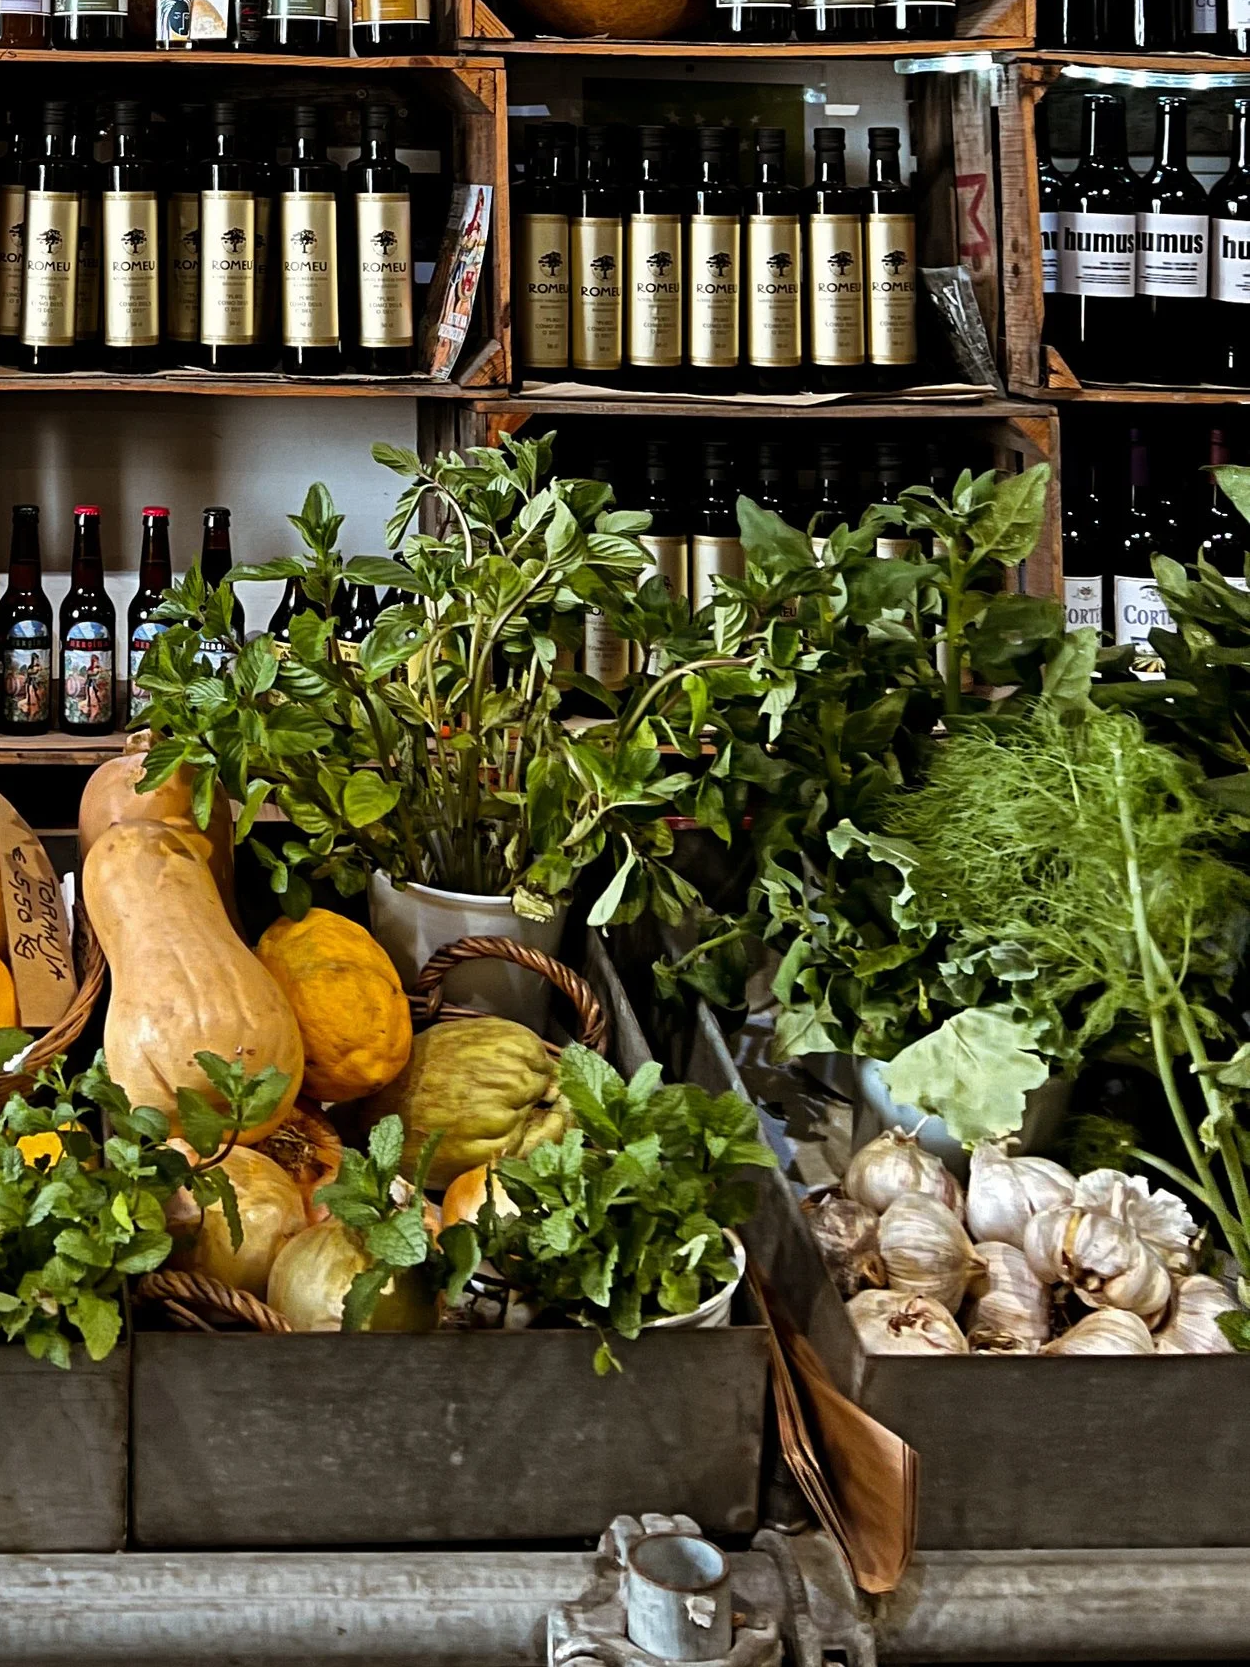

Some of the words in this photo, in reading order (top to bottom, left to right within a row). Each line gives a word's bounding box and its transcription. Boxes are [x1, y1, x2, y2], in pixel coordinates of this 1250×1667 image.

[1063, 227, 1135, 254] humus
[27, 260, 71, 273] ROMEU
[112, 260, 156, 272] ROMEU
[211, 259, 254, 271] ROMEU
[284, 260, 328, 273] ROMEU
[362, 260, 407, 274] ROMEU
[527, 282, 570, 295] ROMEU
[580, 285, 621, 298] ROMEU
[636, 281, 681, 294] ROMEU
[696, 282, 739, 295] ROMEU
[756, 282, 798, 295] ROMEU
[817, 281, 862, 294] ROMEU
[871, 280, 914, 294] ROMEU
[11, 845, 27, 865] €
[8, 870, 33, 924] 5,50
[37, 877, 68, 982] TORANJA
